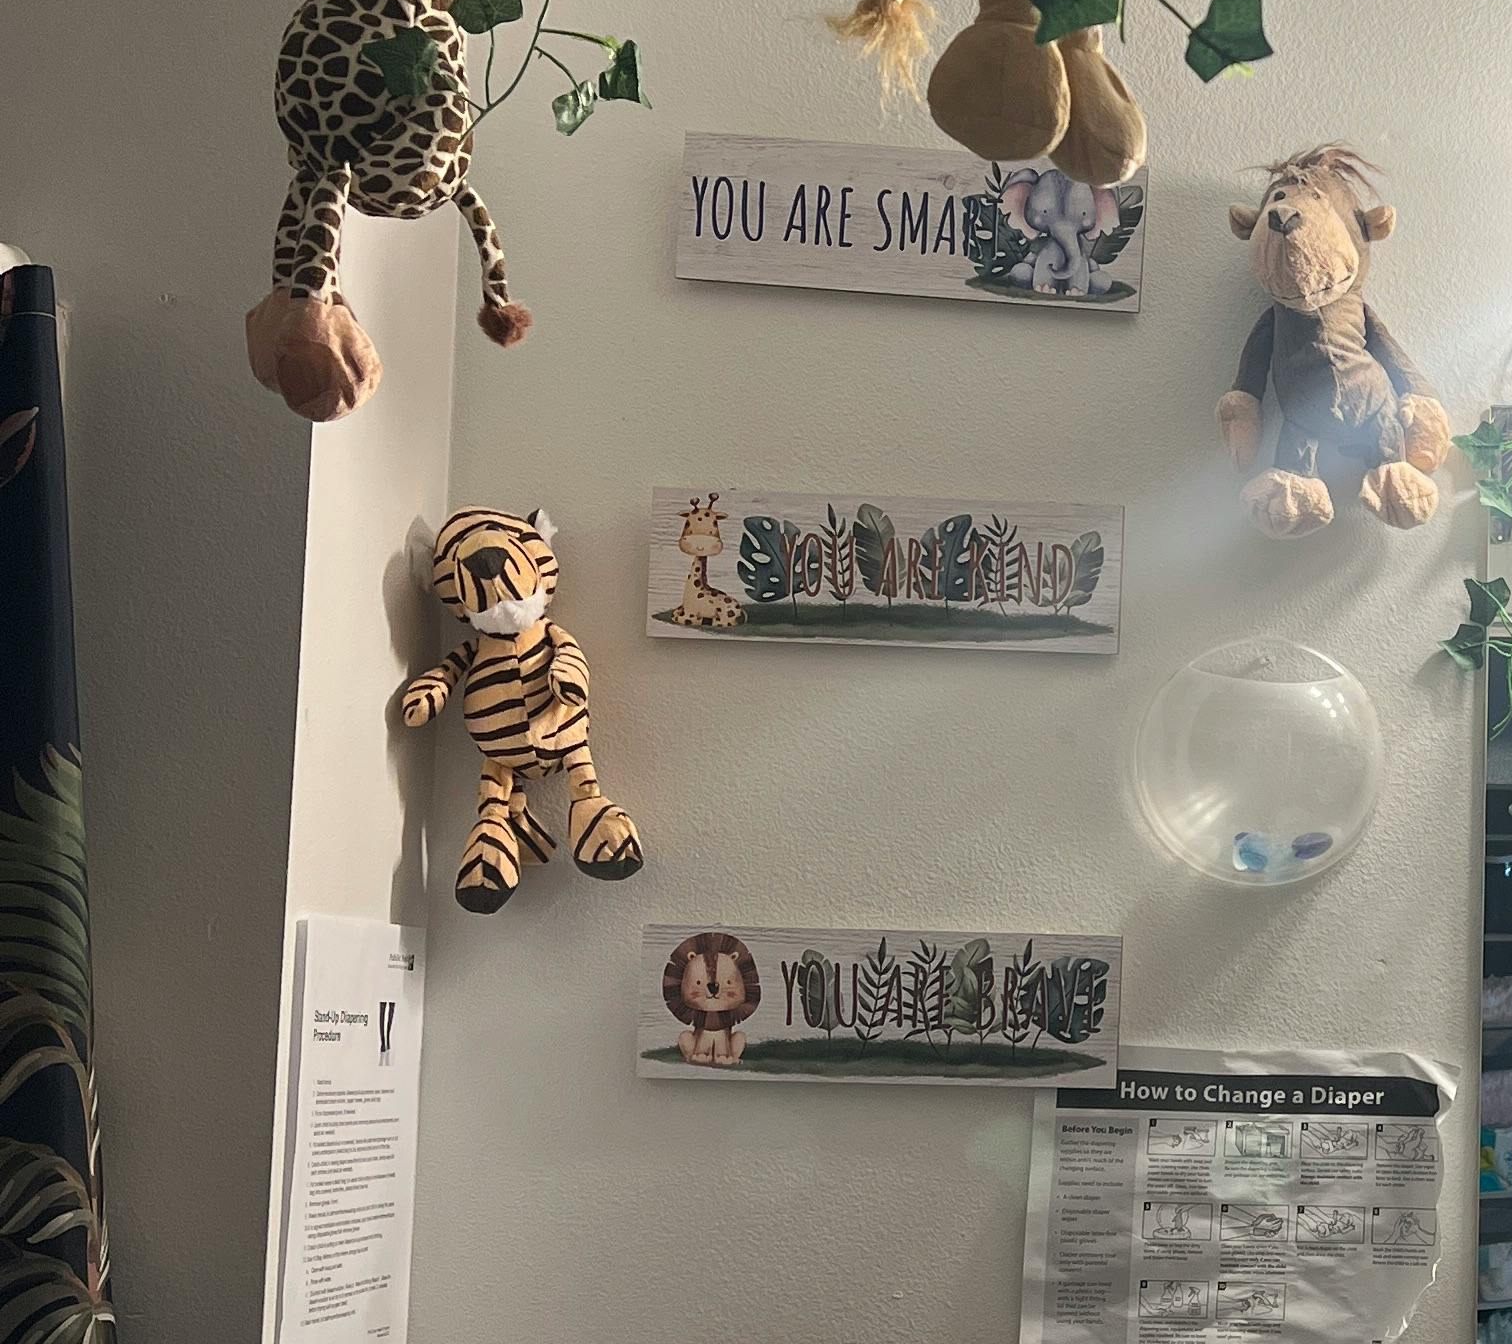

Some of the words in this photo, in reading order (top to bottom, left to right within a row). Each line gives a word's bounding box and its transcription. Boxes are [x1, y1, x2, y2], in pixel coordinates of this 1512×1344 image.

[692, 175, 765, 241] YOU
[783, 183, 853, 247] ARE
[873, 188, 1004, 260] SMART
[784, 532, 855, 599] YOU
[876, 536, 944, 600] ARE
[968, 539, 1075, 606] KIND
[780, 959, 859, 1029] YOU
[880, 963, 953, 1031] ARE
[976, 964, 1101, 1034] BRAVE
[1062, 1124, 1090, 1134] Before
[1091, 1125, 1107, 1134] You
[1108, 1126, 1133, 1136] Begin
[1120, 1081, 1169, 1101] How
[1175, 1085, 1197, 1101] to
[1203, 1084, 1286, 1109] Change
[1292, 1091, 1304, 1104] a
[1311, 1086, 1385, 1109] Diaper
